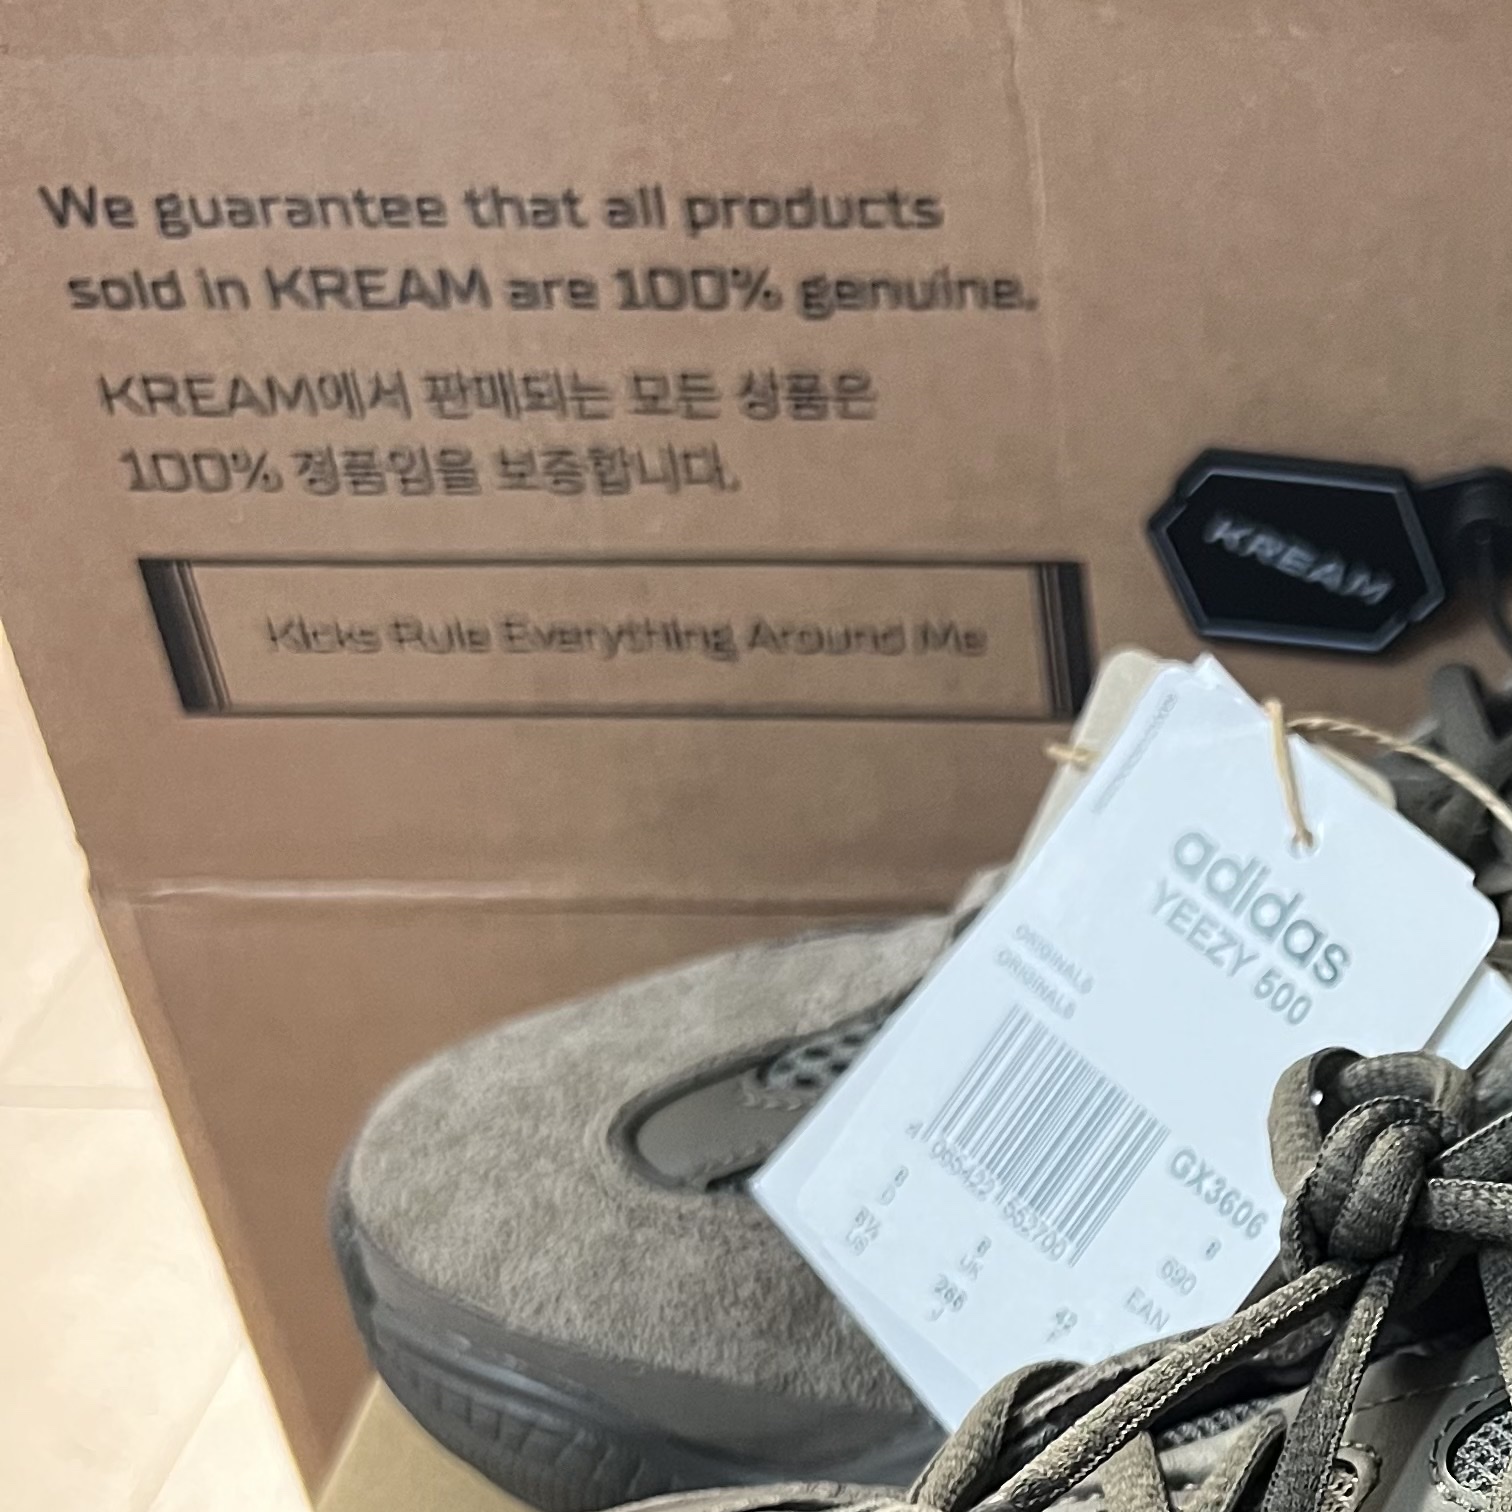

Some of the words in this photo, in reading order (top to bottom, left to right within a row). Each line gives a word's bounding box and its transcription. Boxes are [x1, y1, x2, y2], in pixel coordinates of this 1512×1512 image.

[37, 184, 138, 229] We
[155, 189, 449, 239] guarantee
[464, 185, 589, 229] that
[606, 184, 667, 230] all
[684, 185, 945, 238] products
[69, 269, 187, 311] sold
[198, 267, 251, 311] in
[265, 266, 493, 311] KREAM
[507, 277, 599, 311] are
[613, 265, 783, 312] 100%
[797, 265, 1040, 321] genuine.
[97, 368, 414, 421] KREAM에서
[421, 368, 612, 421] 판매되는
[626, 369, 723, 421] 모든
[736, 367, 878, 421] 상품은
[118, 446, 285, 494] 100%
[291, 444, 482, 497] 정품임을
[497, 440, 742, 497] 보증합니다.
[1204, 518, 1395, 606] KREAM
[265, 613, 384, 654] Kicks
[389, 613, 492, 655] Rule
[501, 613, 740, 663] Everything
[747, 613, 906, 656] Around
[912, 615, 988, 656] Me
[1173, 831, 1352, 989] adidas
[1152, 876, 1259, 979] YEEZY
[1253, 967, 1313, 1027] 500
[1168, 1147, 1269, 1240] GX3606
[1124, 1286, 1171, 1334] EAN
